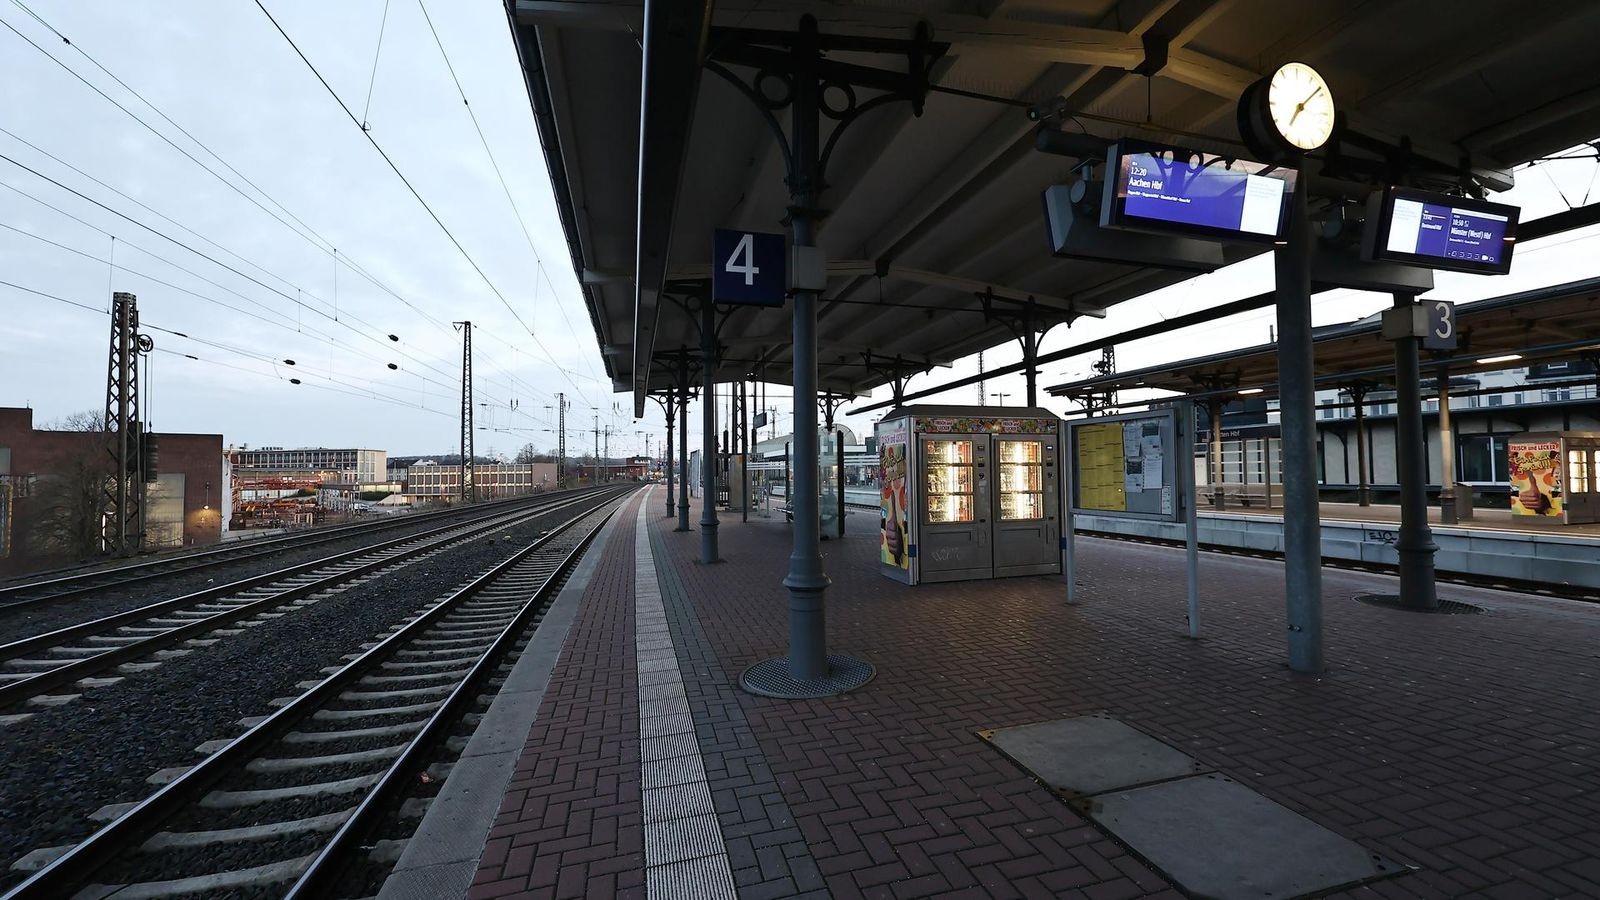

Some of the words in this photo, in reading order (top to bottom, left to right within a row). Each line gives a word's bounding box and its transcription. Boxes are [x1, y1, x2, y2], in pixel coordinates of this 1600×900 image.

[1129, 177, 1150, 188] Aachen
[1151, 180, 1163, 190] Hbf
[1131, 167, 1147, 176] 12:20
[725, 234, 759, 285] 4
[1435, 302, 1452, 339] 3
